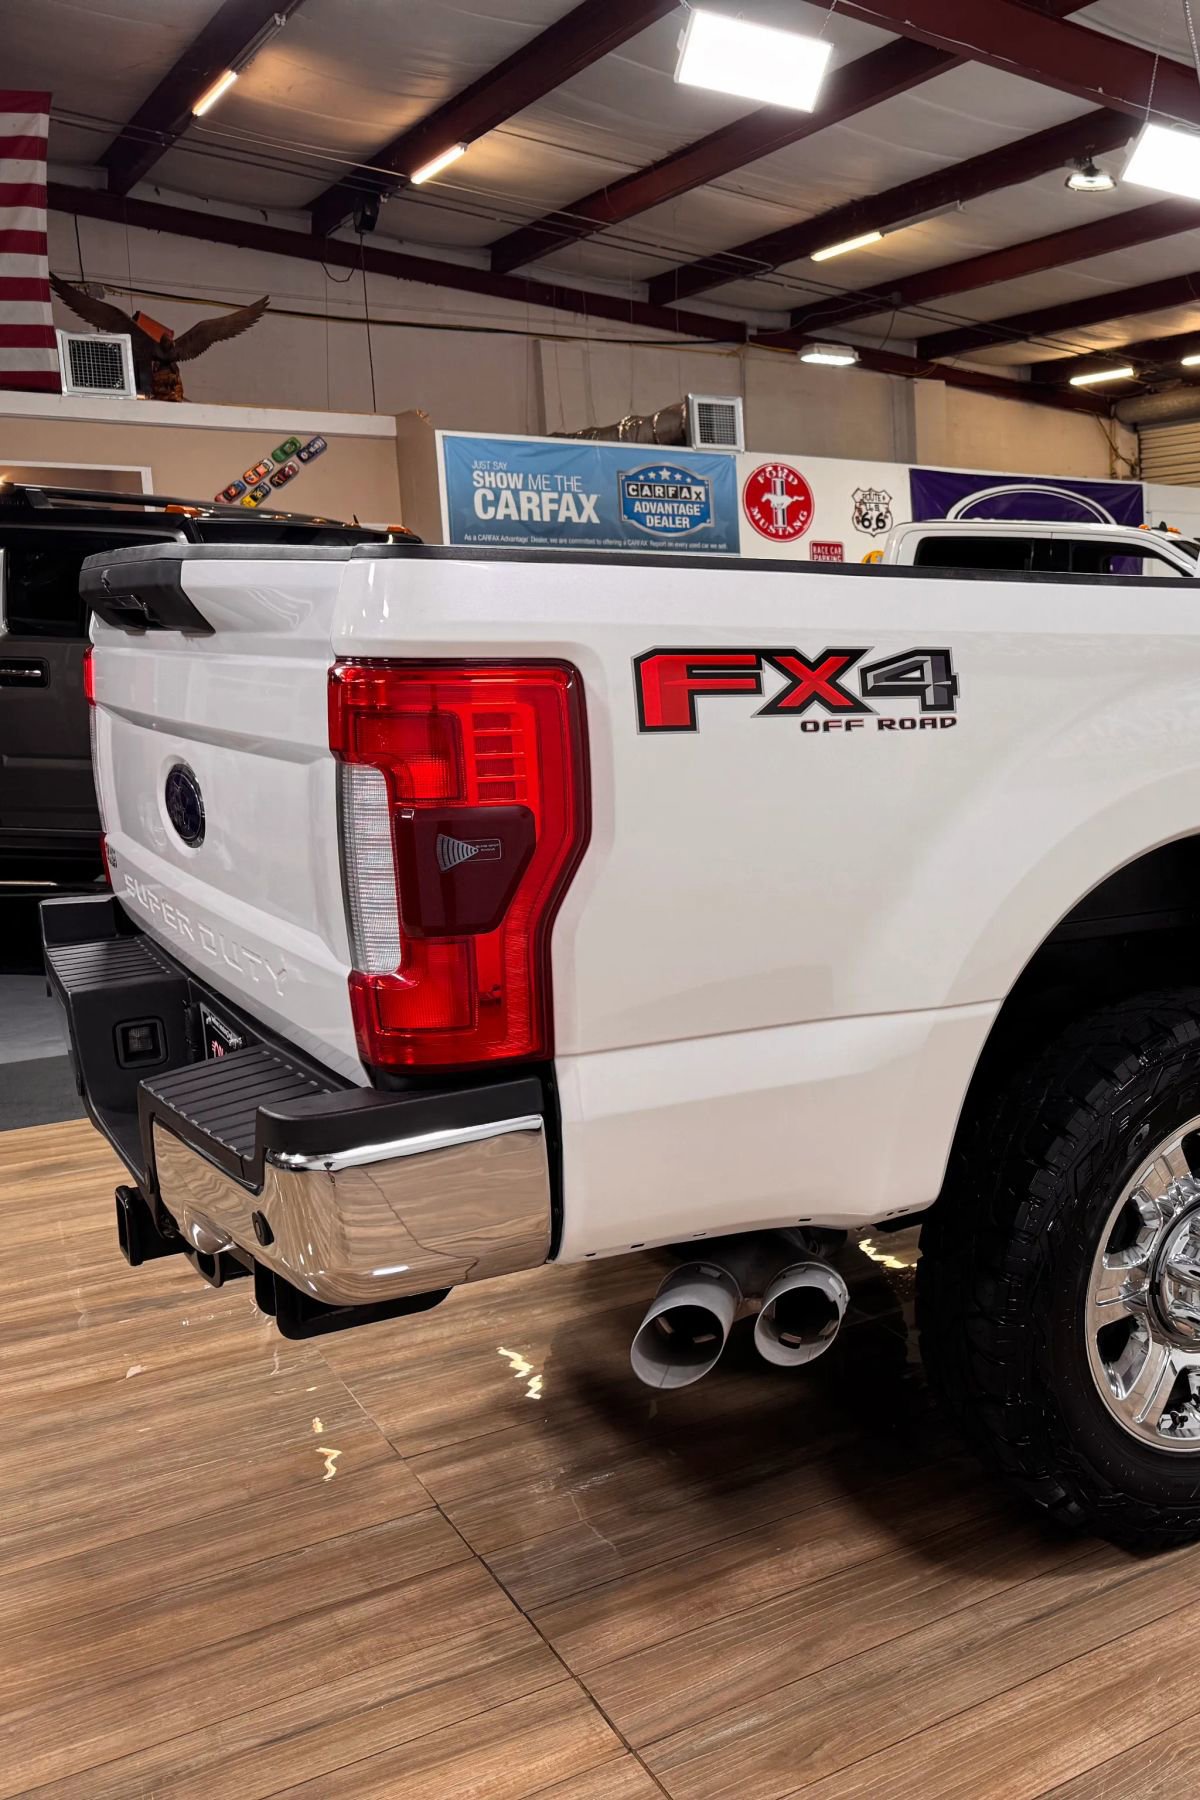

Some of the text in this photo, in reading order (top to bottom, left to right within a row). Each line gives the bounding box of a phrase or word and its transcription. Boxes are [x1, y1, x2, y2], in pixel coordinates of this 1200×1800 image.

[472, 460, 508, 471] JUST SAY
[473, 470, 583, 493] SHOW ME THE
[757, 465, 799, 486] FORD
[627, 484, 703, 501] CARFAX
[862, 493, 881, 502] ROUTE
[474, 488, 601, 524] CARFAX
[633, 500, 701, 516] ADVANTAGE
[646, 515, 690, 529] DEALER
[750, 505, 808, 536] MUSTANG
[861, 511, 886, 530] 66
[478, 534, 500, 542] CARFAX
[627, 539, 648, 547] CARFAX
[813, 545, 842, 555] RACE CAR
[631, 645, 960, 735] FX4
[800, 716, 957, 733] OFF ROAD
[124, 873, 288, 997] SUPER DUTY
